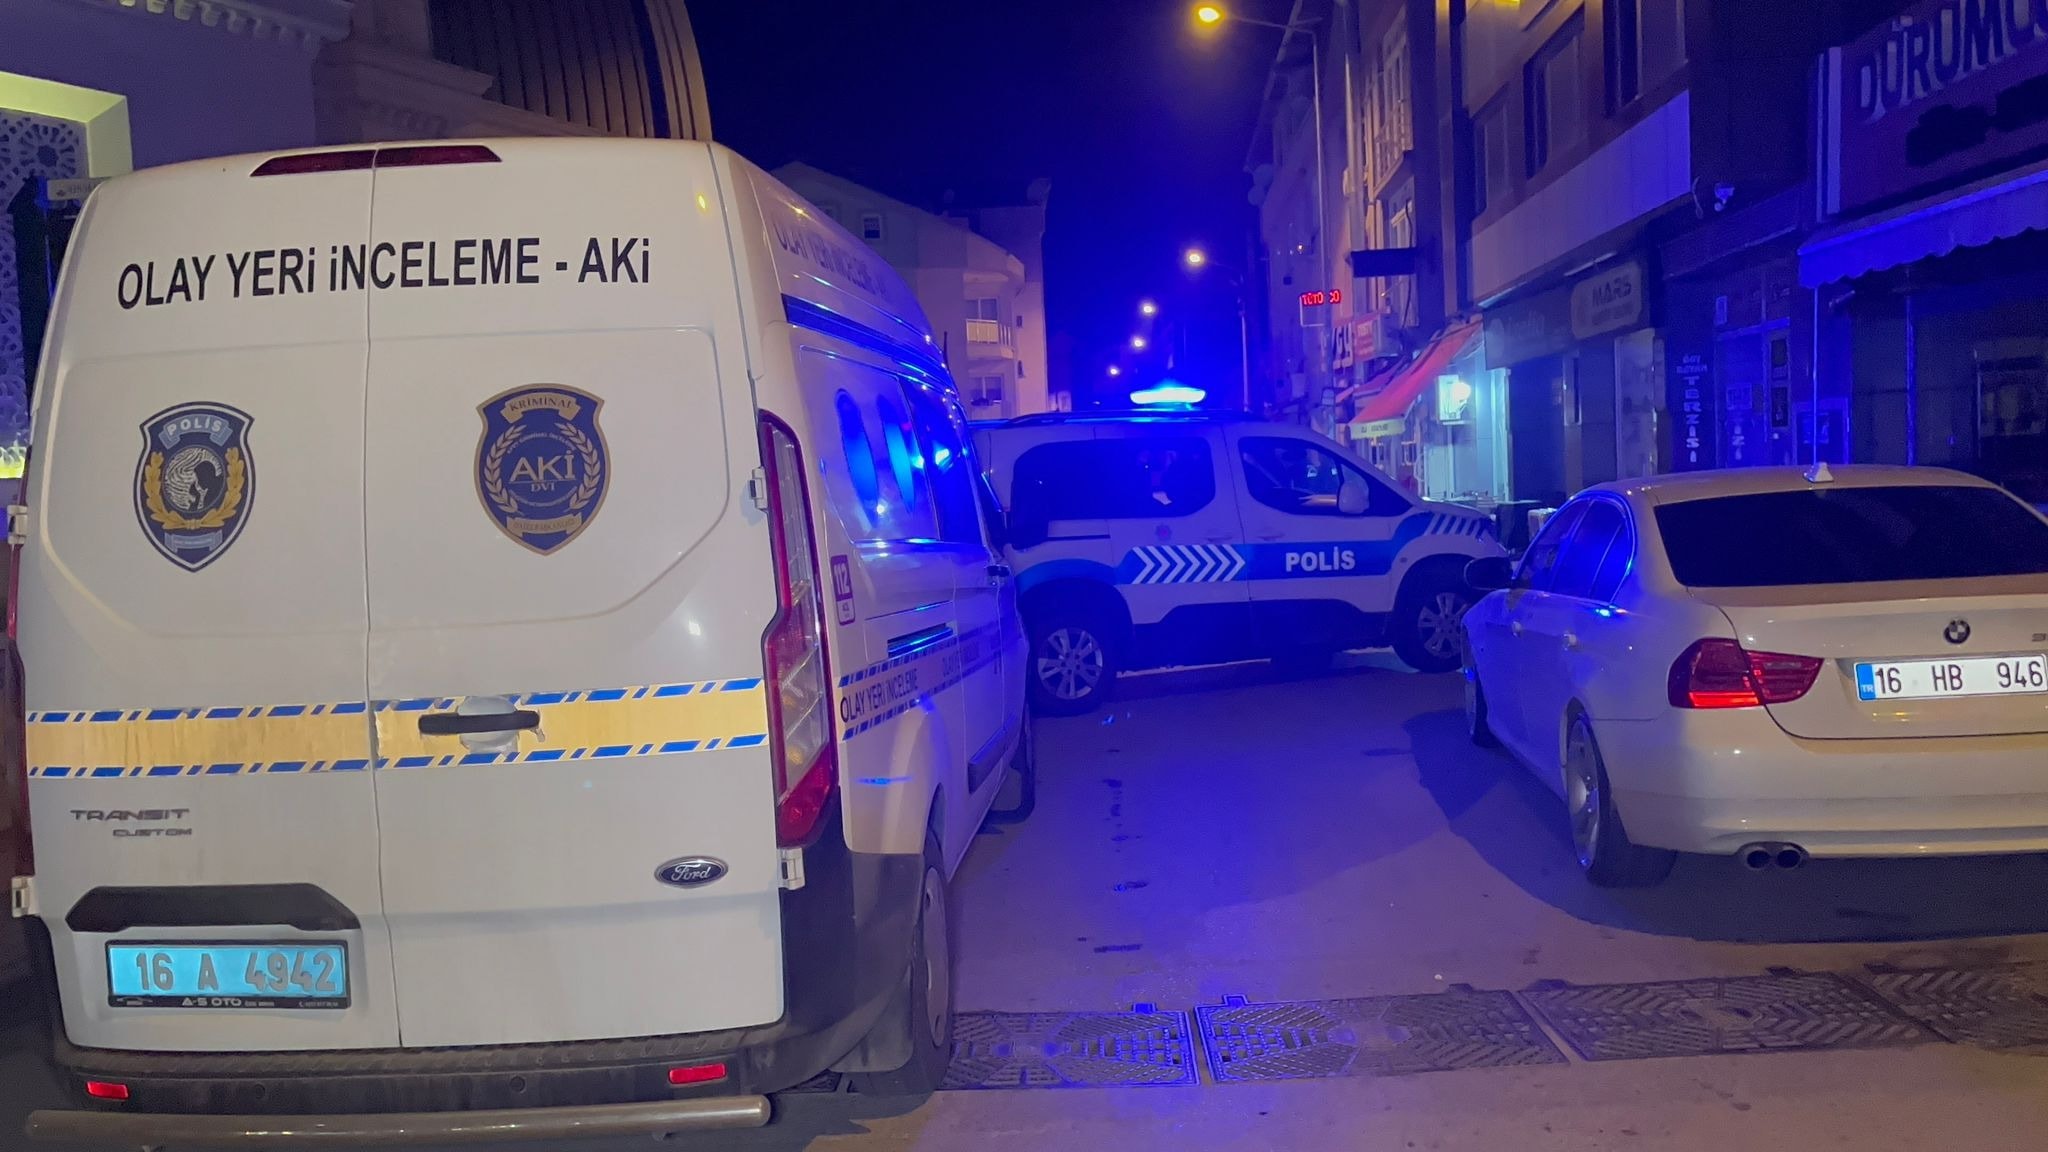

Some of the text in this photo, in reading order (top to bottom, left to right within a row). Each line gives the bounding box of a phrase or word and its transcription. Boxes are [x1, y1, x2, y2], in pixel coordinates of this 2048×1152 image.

[118, 254, 216, 310] OLAY
[166, 416, 223, 436] POLİS
[509, 450, 576, 482] AKİ
[1285, 546, 1356, 572] POLİS
[1861, 660, 2044, 694] TR 16 HB 946
[840, 690, 866, 723] OLAY
[70, 808, 190, 820] TRANSIT
[112, 828, 193, 837] CUSTOM
[671, 863, 712, 881] Ford
[136, 952, 337, 992] 16 A 4942
